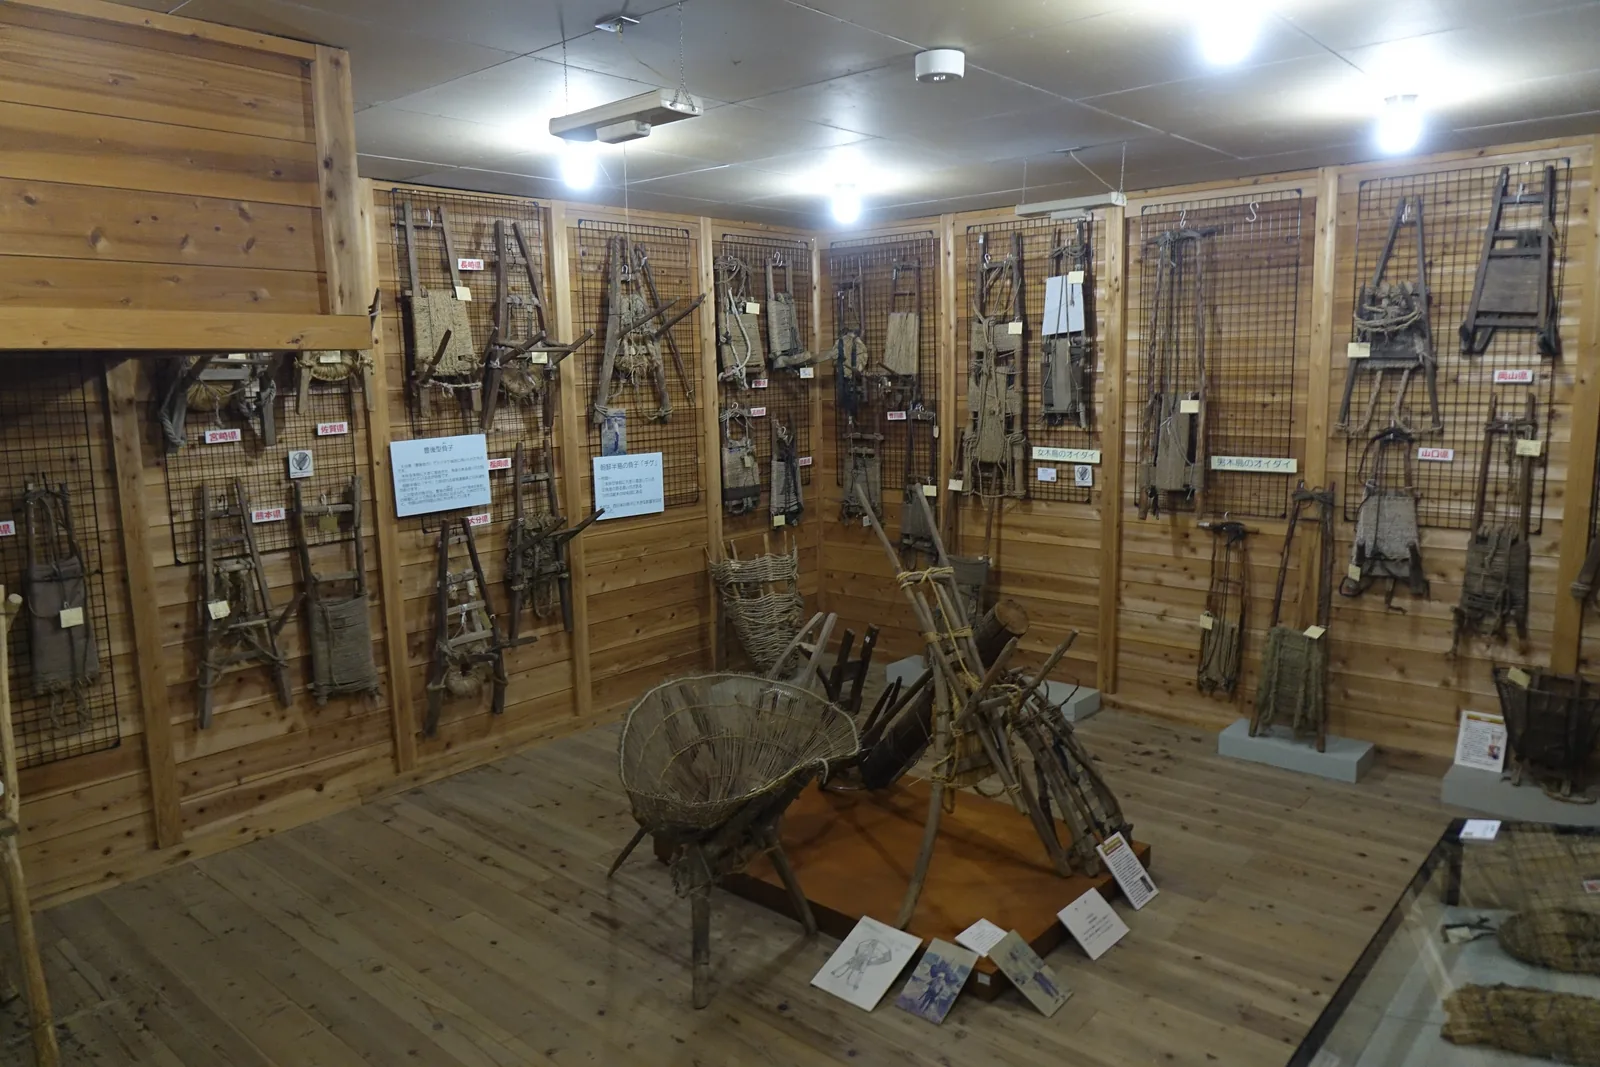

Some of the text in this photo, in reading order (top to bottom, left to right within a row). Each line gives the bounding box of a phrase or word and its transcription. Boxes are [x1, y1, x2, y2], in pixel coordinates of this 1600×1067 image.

[461, 261, 482, 269] 長崎県
[321, 424, 344, 434] 佐賀県
[209, 431, 237, 442] 宮崎県
[1421, 449, 1449, 459] 山口県
[255, 510, 281, 520] 熊本県
[469, 514, 489, 525] 大分県
